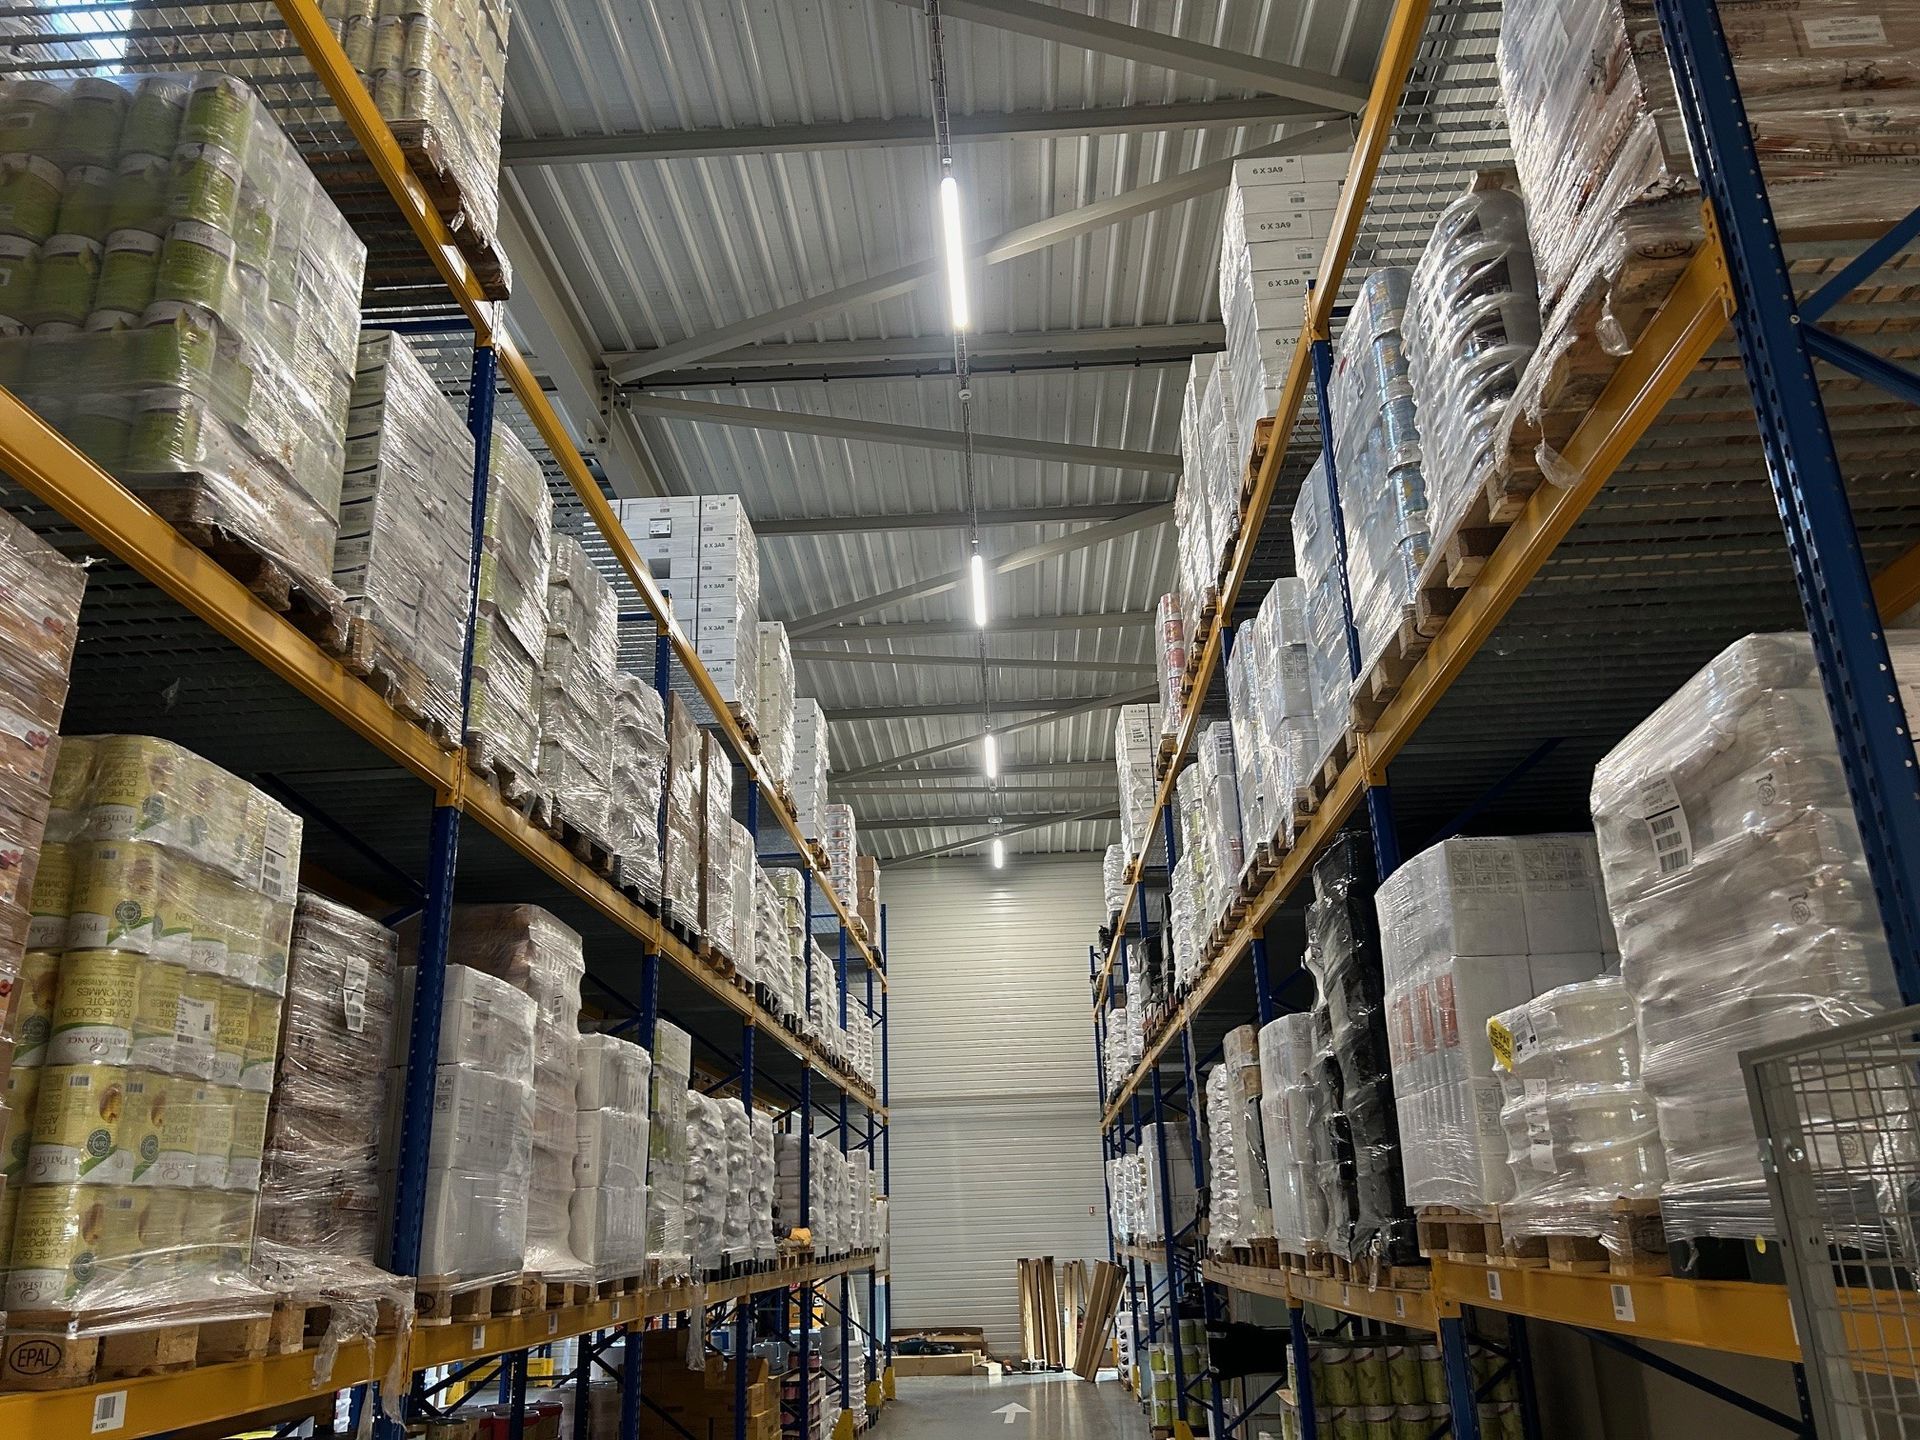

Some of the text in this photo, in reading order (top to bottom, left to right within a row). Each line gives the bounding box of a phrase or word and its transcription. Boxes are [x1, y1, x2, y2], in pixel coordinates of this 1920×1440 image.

[1267, 166, 1283, 174] 3A9
[1275, 221, 1291, 229] 3A9
[1283, 278, 1300, 286] 3A9
[86, 997, 132, 1008] COMPOTE
[105, 1007, 130, 1019] PURE
[34, 1248, 67, 1260] PURE
[17, 1347, 53, 1368] EPAL
